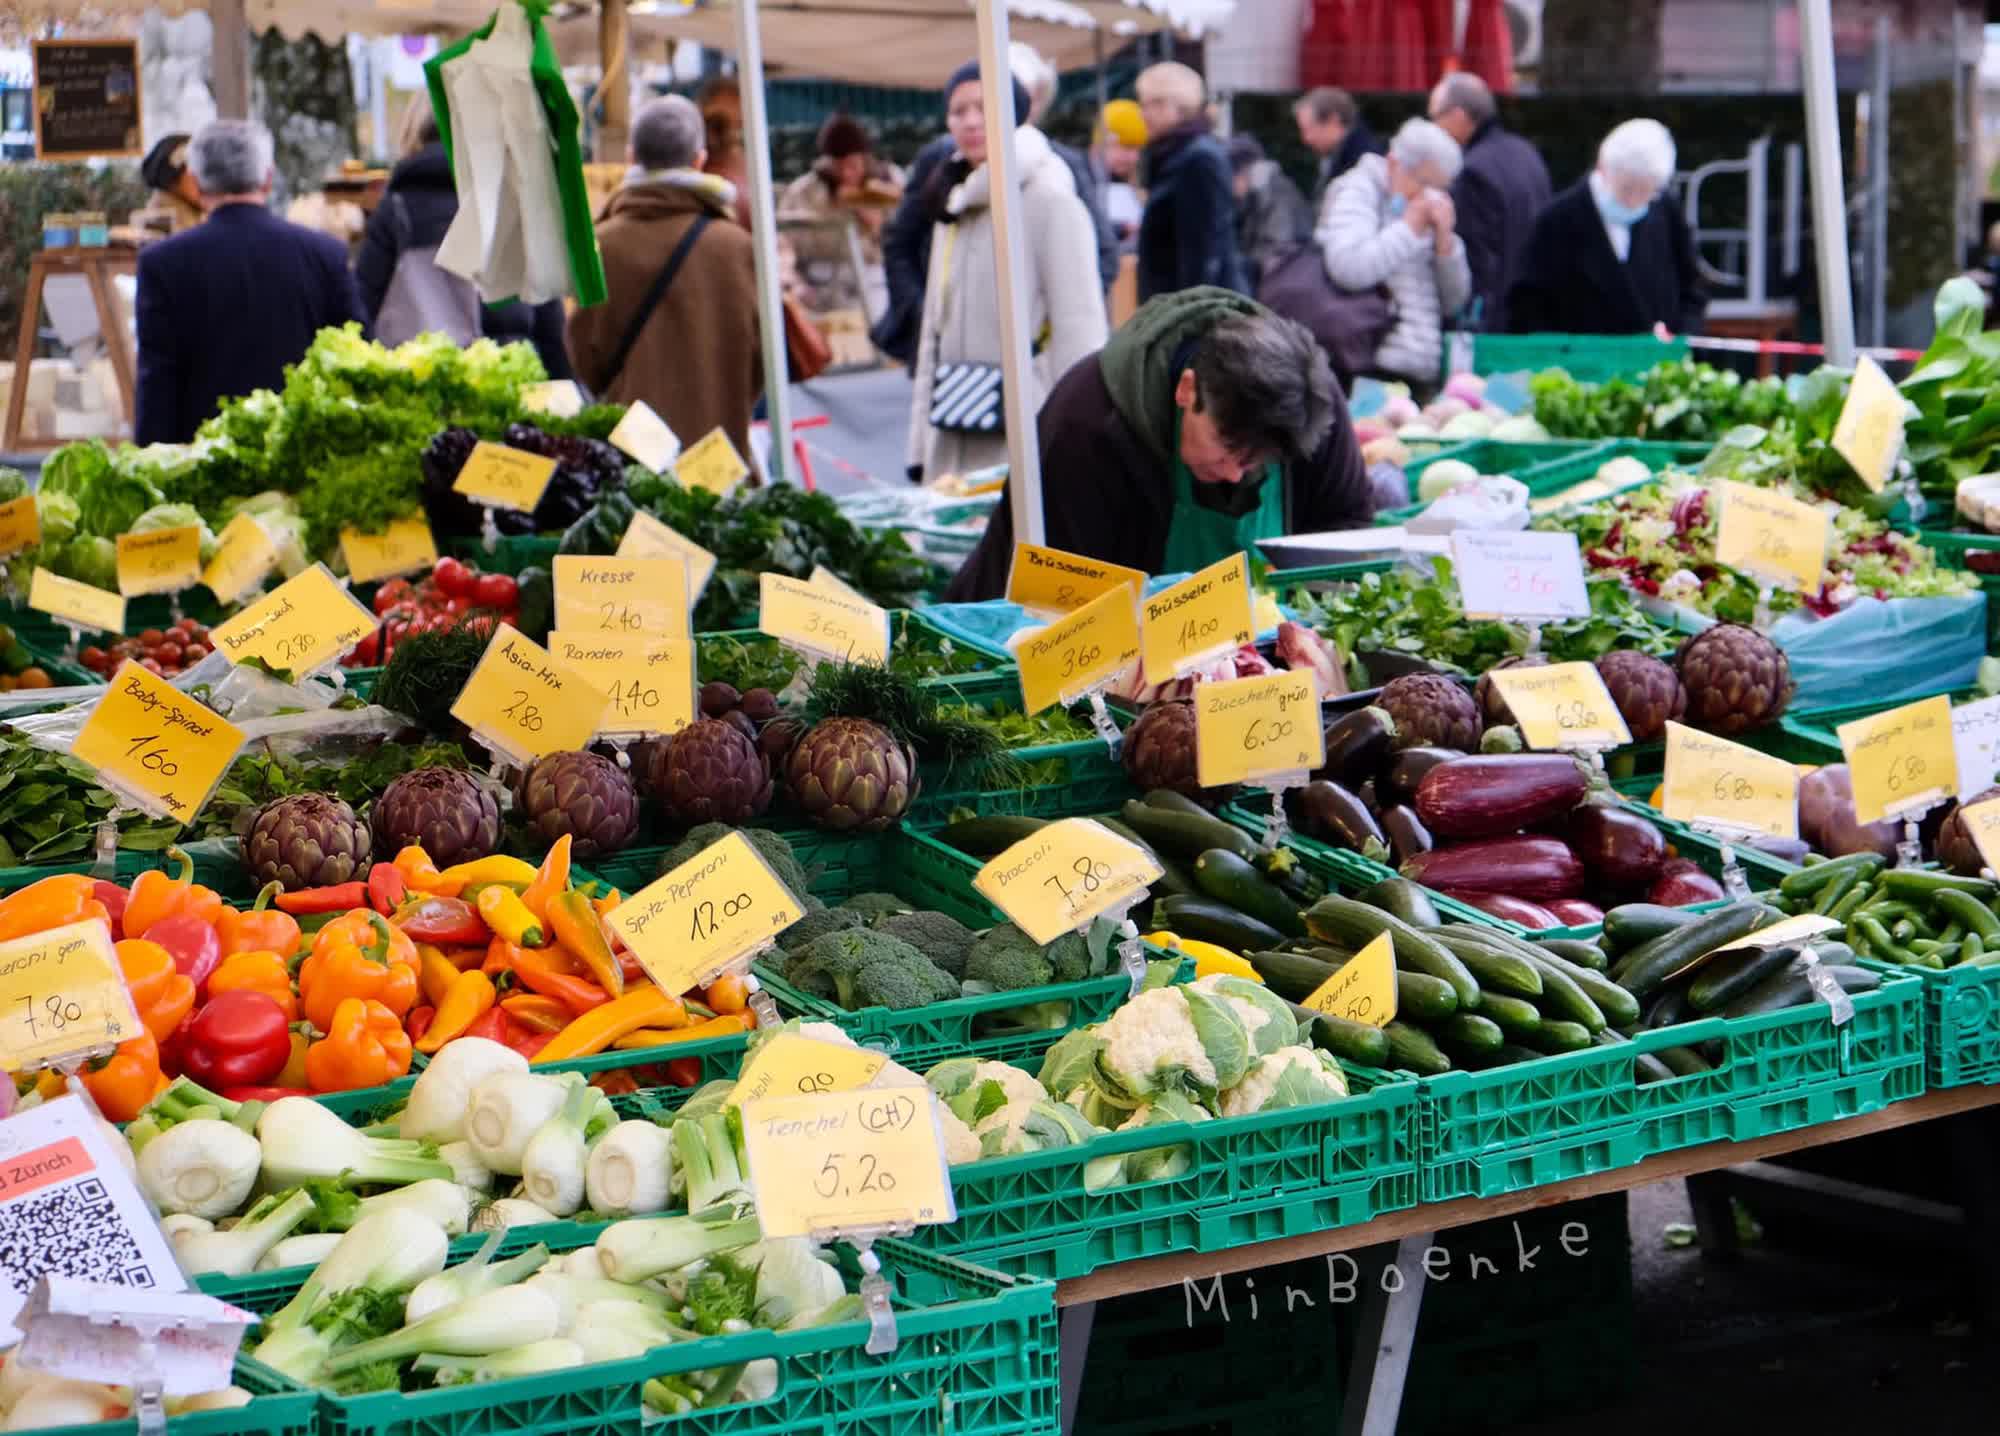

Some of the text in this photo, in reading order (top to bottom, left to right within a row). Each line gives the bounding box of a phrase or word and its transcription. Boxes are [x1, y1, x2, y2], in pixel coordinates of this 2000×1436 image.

[580, 568, 635, 584] Kresse
[1025, 551, 1107, 579] Brüsseler
[1147, 566, 1240, 620] Brüsseler rot
[501, 641, 562, 689] Asia-Mix
[563, 643, 623, 660] Randen
[992, 840, 1054, 886] Broccoli
[1044, 856, 1112, 908] 7.80
[626, 854, 728, 934] Spitz-Peperoni
[691, 893, 752, 941] 12.00
[16, 995, 82, 1038] 7.80
[857, 1096, 915, 1133] (CH)
